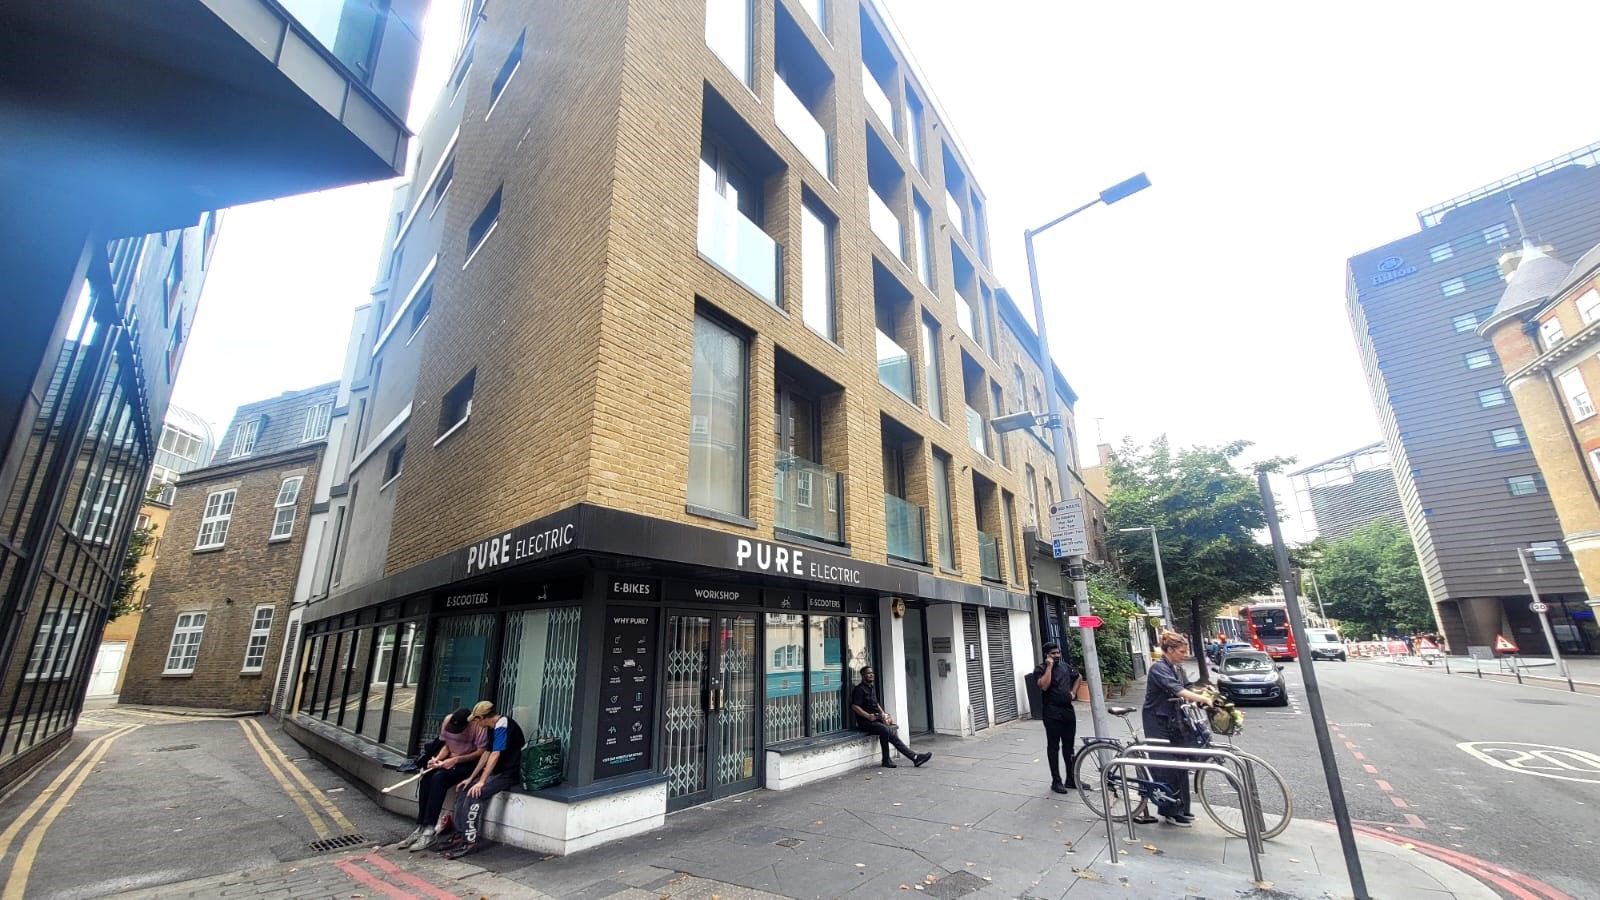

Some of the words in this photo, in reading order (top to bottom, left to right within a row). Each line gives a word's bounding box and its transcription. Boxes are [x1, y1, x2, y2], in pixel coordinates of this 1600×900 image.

[467, 533, 511, 573] PURE
[515, 523, 574, 560] ELECTRIC
[736, 539, 804, 575] PURE
[810, 562, 861, 584] ELECTRIC
[613, 582, 650, 595] E-BIKES
[694, 588, 740, 602] WORKSHOP
[446, 592, 489, 607] E-SCOOTERS
[809, 597, 841, 609] E-SCOOTERS
[613, 616, 629, 625] WHY
[630, 616, 649, 626] PURE?
[464, 803, 480, 843] didas
